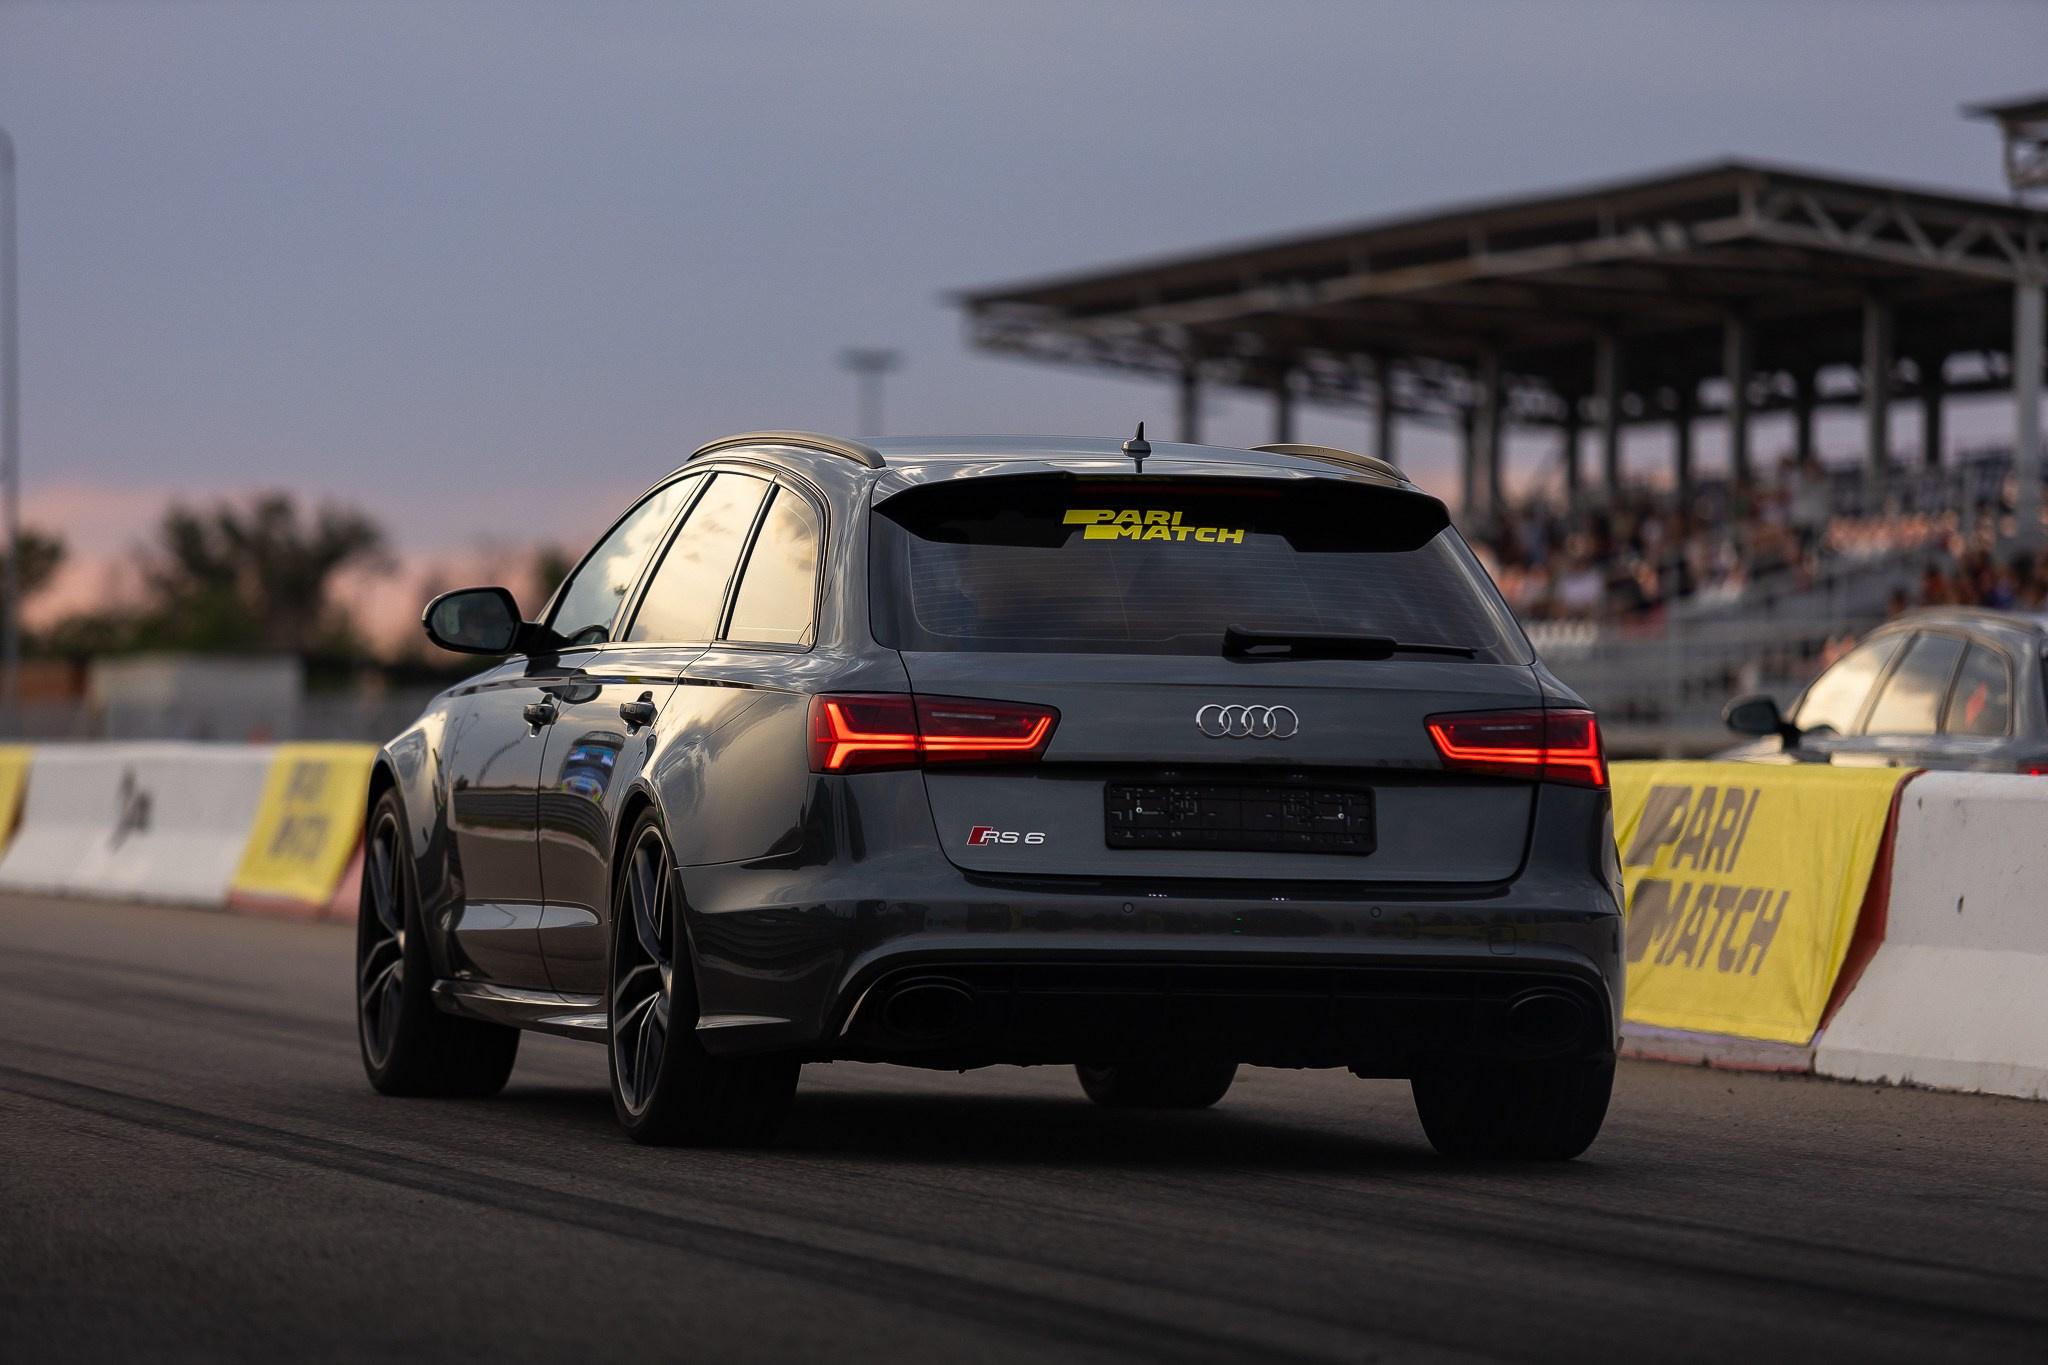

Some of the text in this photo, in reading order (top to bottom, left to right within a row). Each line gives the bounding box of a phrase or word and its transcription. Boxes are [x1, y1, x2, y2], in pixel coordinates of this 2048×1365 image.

[1063, 509, 1183, 525] PARI
[1084, 524, 1245, 544] MATCH
[979, 830, 1046, 845] RS 6
[1624, 785, 1761, 874] PARI
[1625, 877, 1791, 976] MATCH
